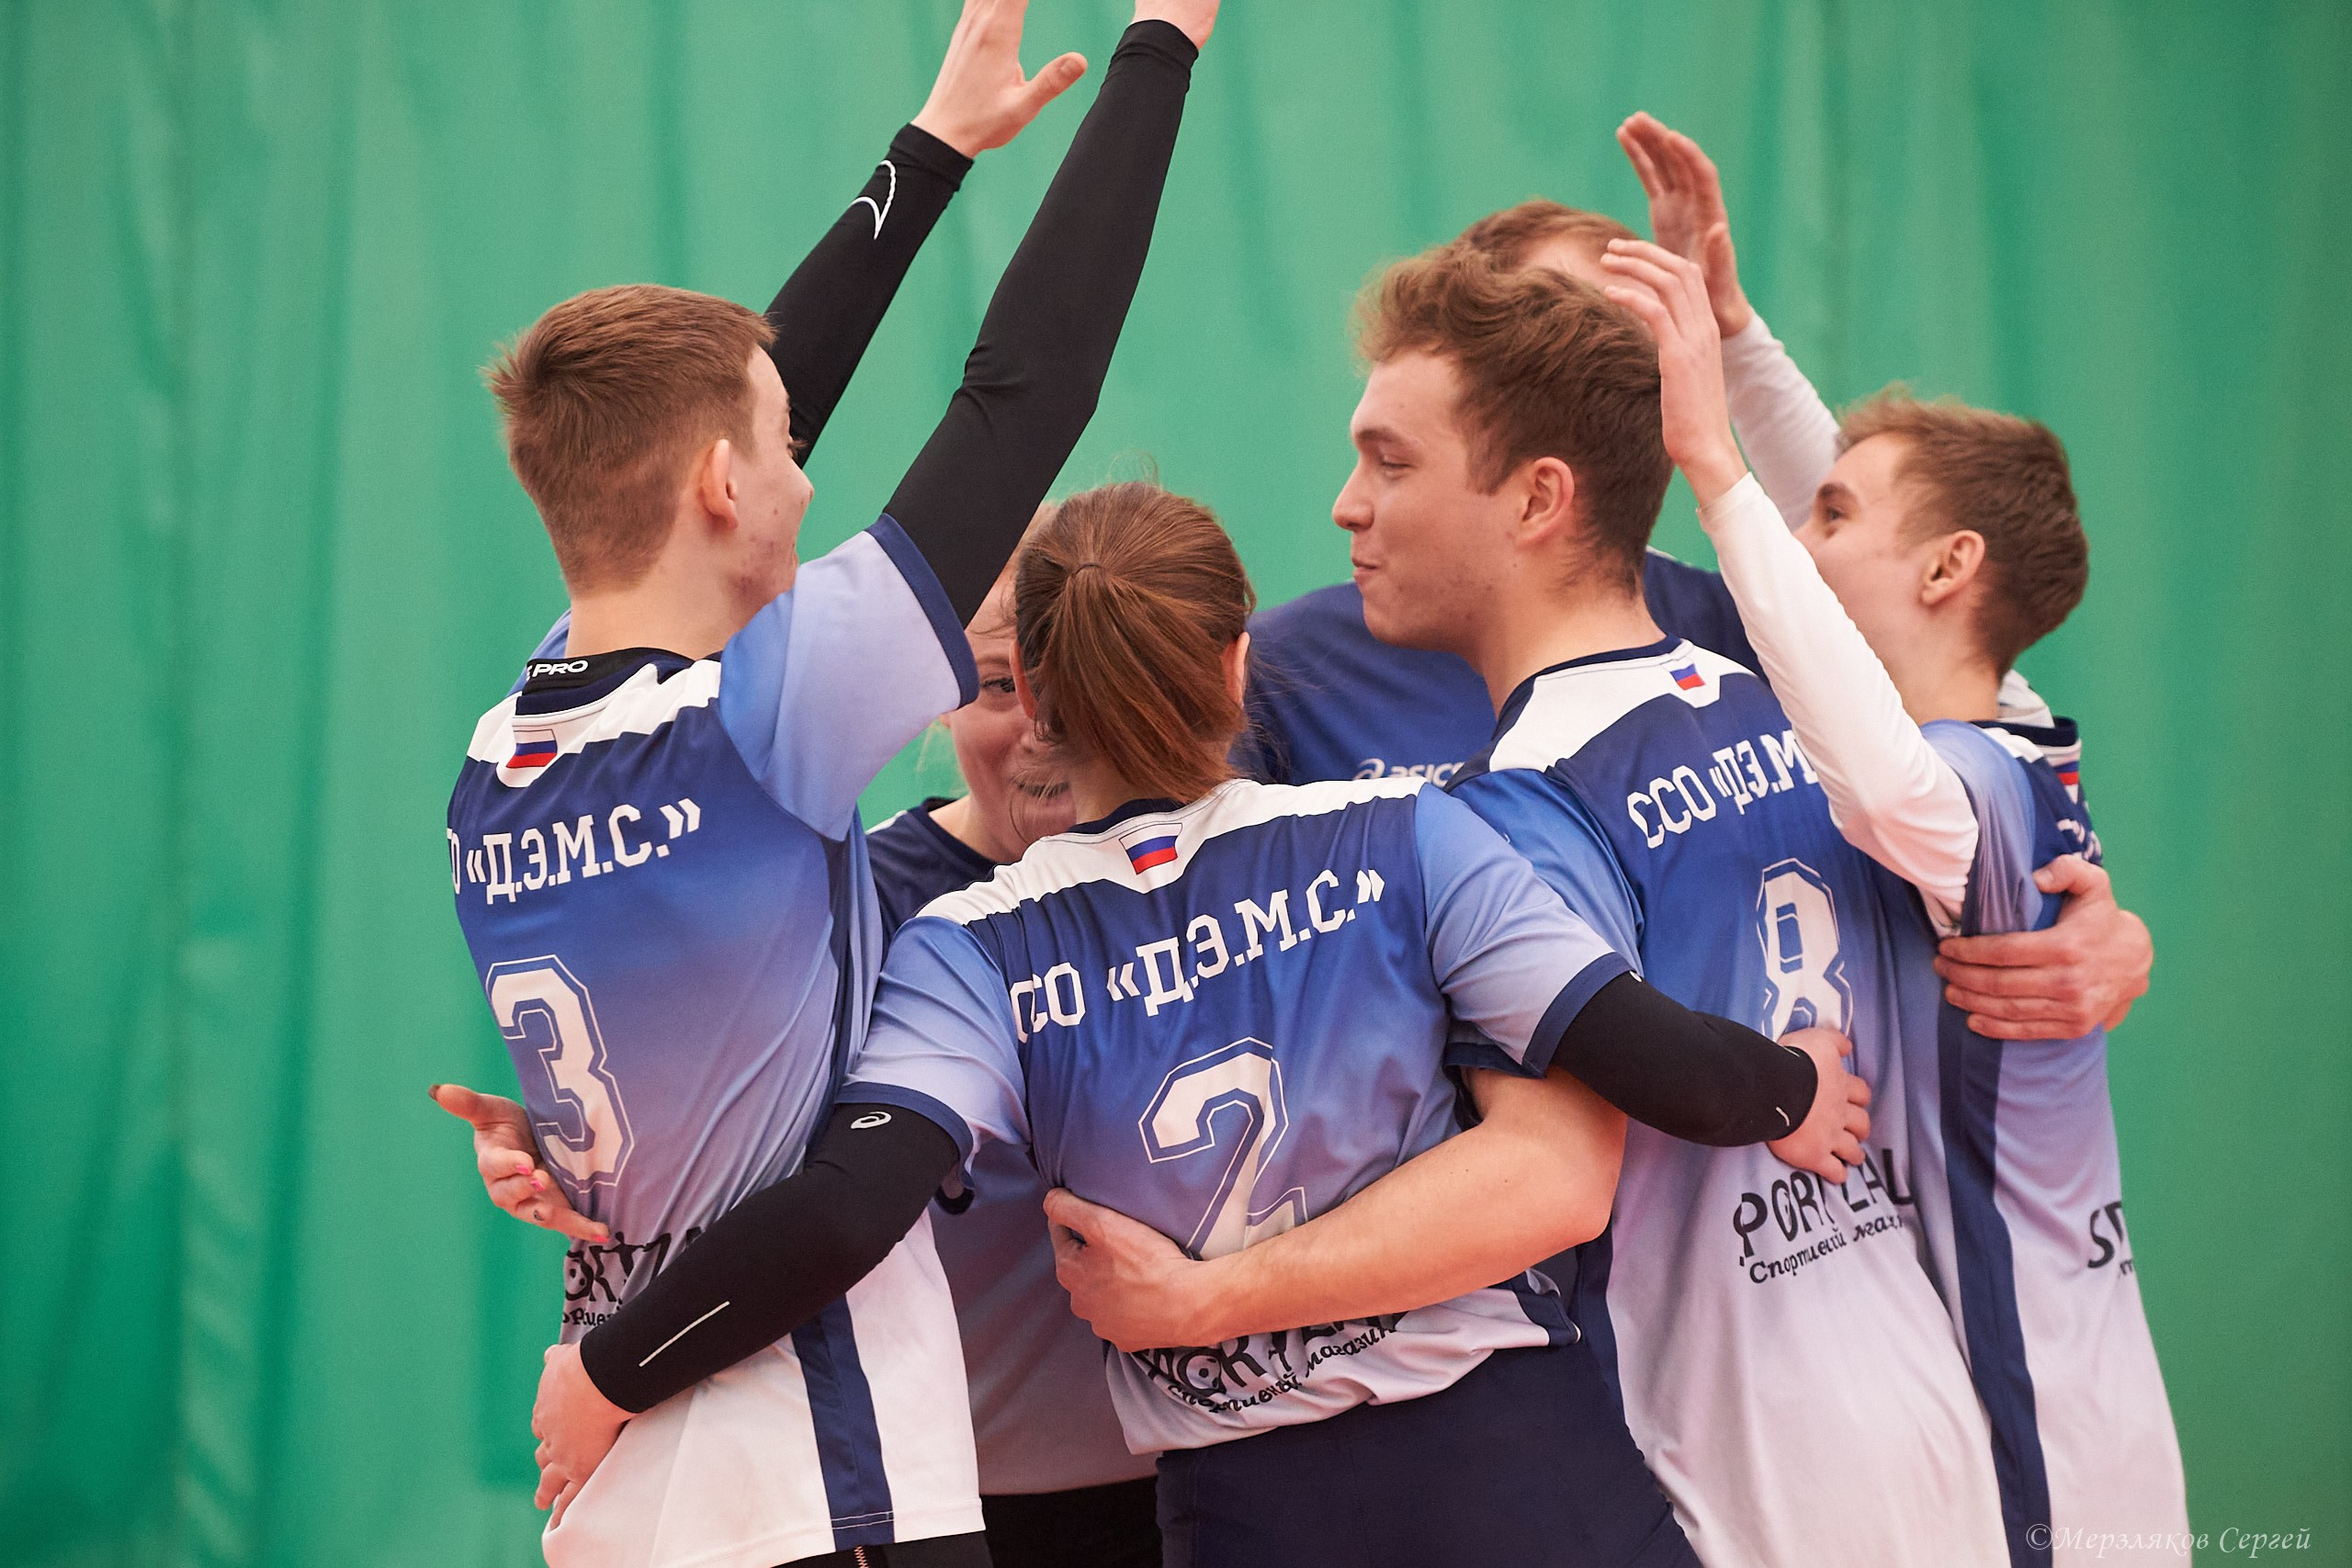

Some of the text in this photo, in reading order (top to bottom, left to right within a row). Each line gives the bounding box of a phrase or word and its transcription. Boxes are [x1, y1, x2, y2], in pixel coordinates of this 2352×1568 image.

[532, 660, 589, 677] PRO
[466, 797, 701, 905] «Д.Э.М.С.»
[1627, 764, 1717, 849] ССО
[1106, 869, 1385, 1017] «Д.Э.М.С.»
[1756, 857, 1854, 1040] 8
[485, 953, 636, 1194] 3
[1137, 1036, 1309, 1262] 2
